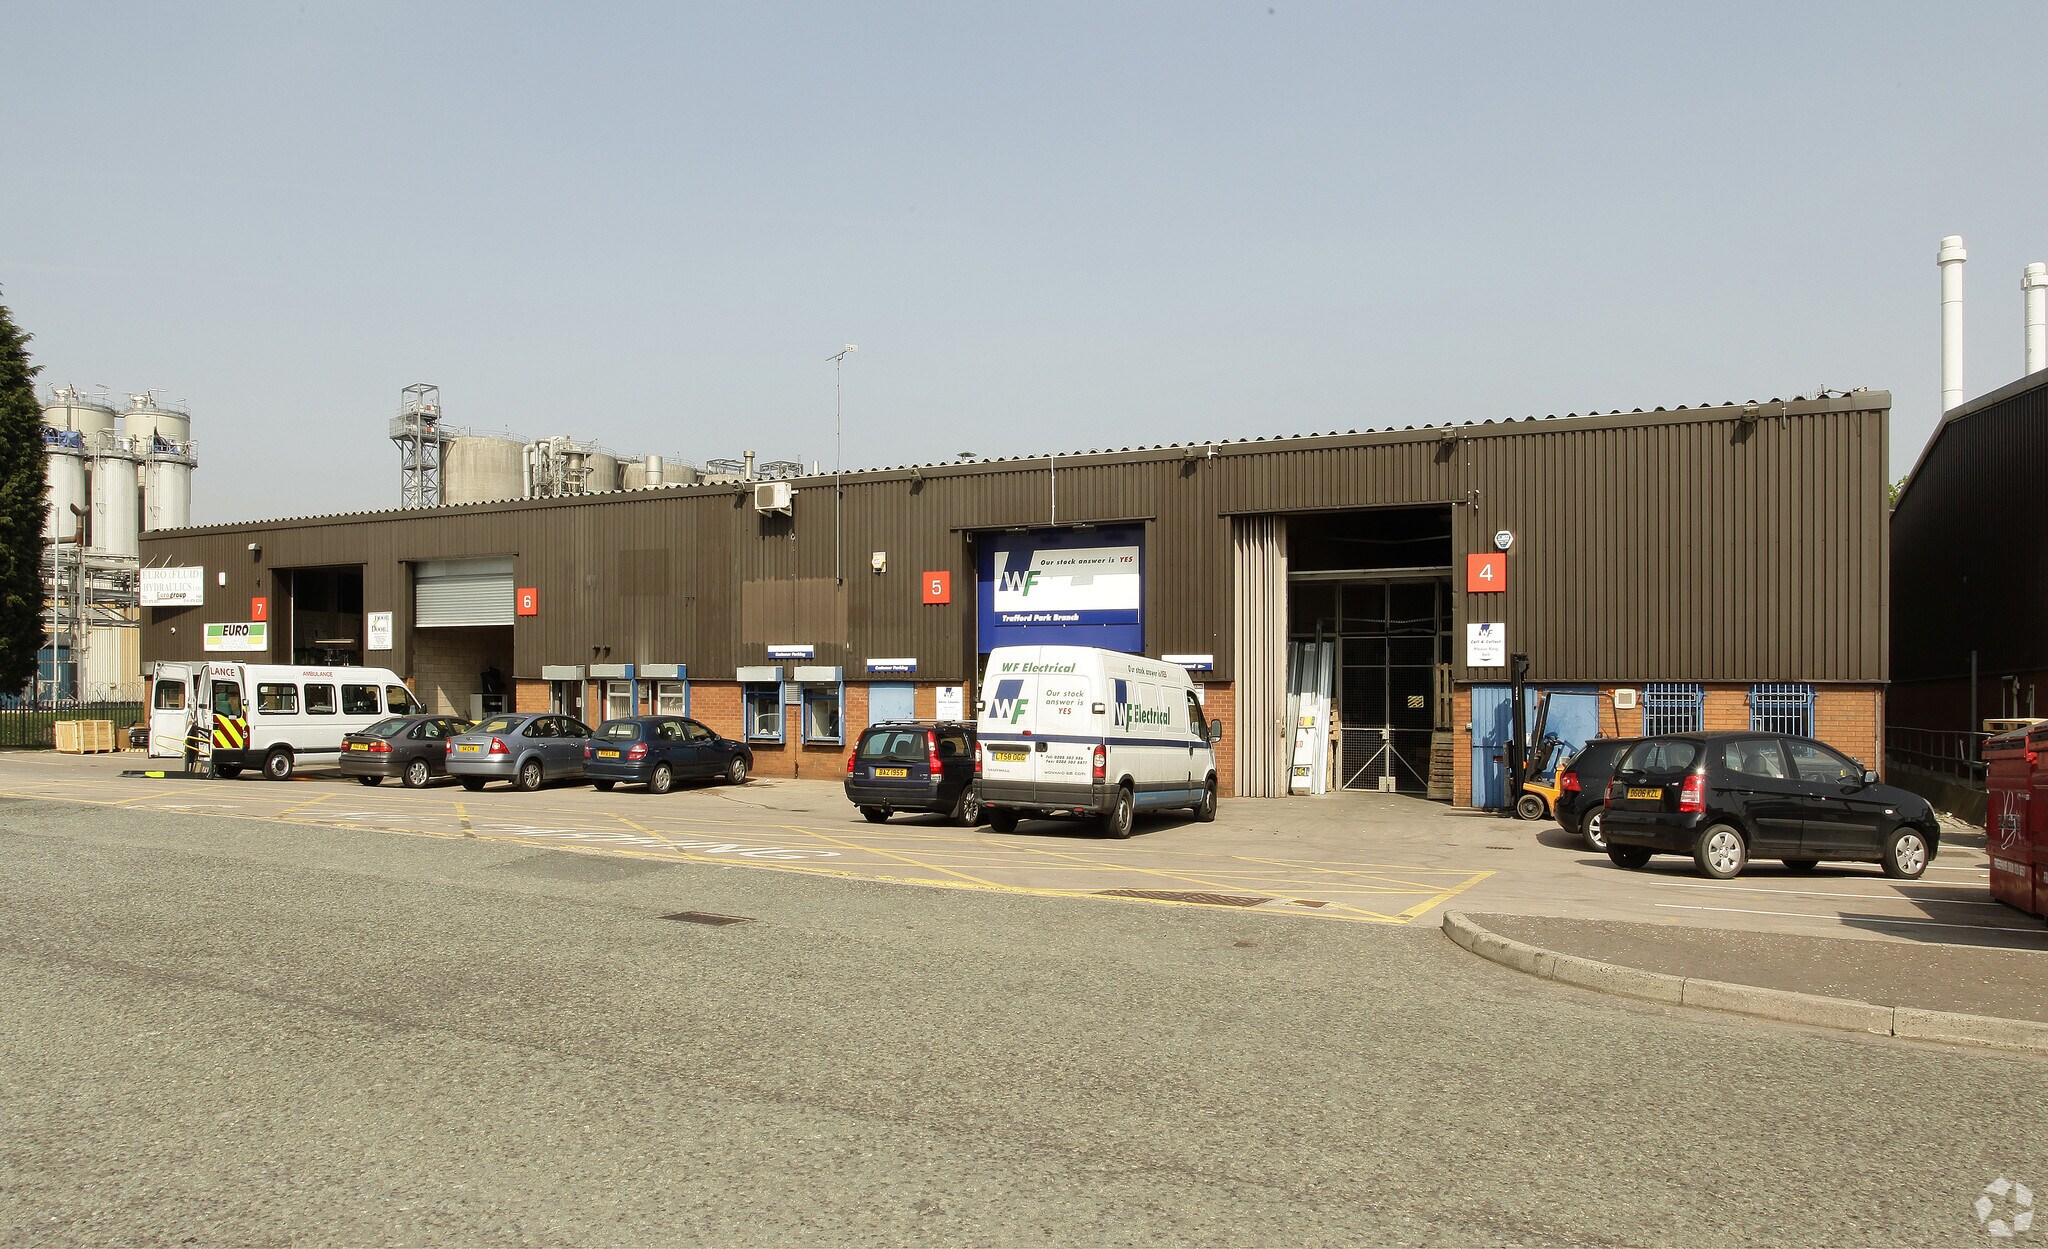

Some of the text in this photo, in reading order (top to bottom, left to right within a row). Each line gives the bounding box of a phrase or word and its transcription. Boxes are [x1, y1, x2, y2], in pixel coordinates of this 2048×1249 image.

[142, 569, 203, 580] EURO (FLUID)
[1478, 563, 1494, 582] 4
[143, 582, 192, 592] HYDRAULICS
[931, 579, 942, 595] 5
[998, 570, 1042, 597] WF
[523, 595, 532, 608] 6
[256, 603, 264, 615] 7
[1002, 613, 1080, 622] Trafford Park Branch
[222, 624, 249, 636] EURO
[210, 667, 235, 677] LANCE
[1002, 662, 1077, 673] WF Electrical
[1135, 666, 1145, 675] stock
[1145, 668, 1158, 677] answer
[1045, 689, 1084, 698] Our stock
[989, 698, 1029, 725] WF
[1058, 707, 1072, 715] YES
[1114, 702, 1171, 733] WF Electrical
[1630, 788, 1659, 798] DG06 KZL
